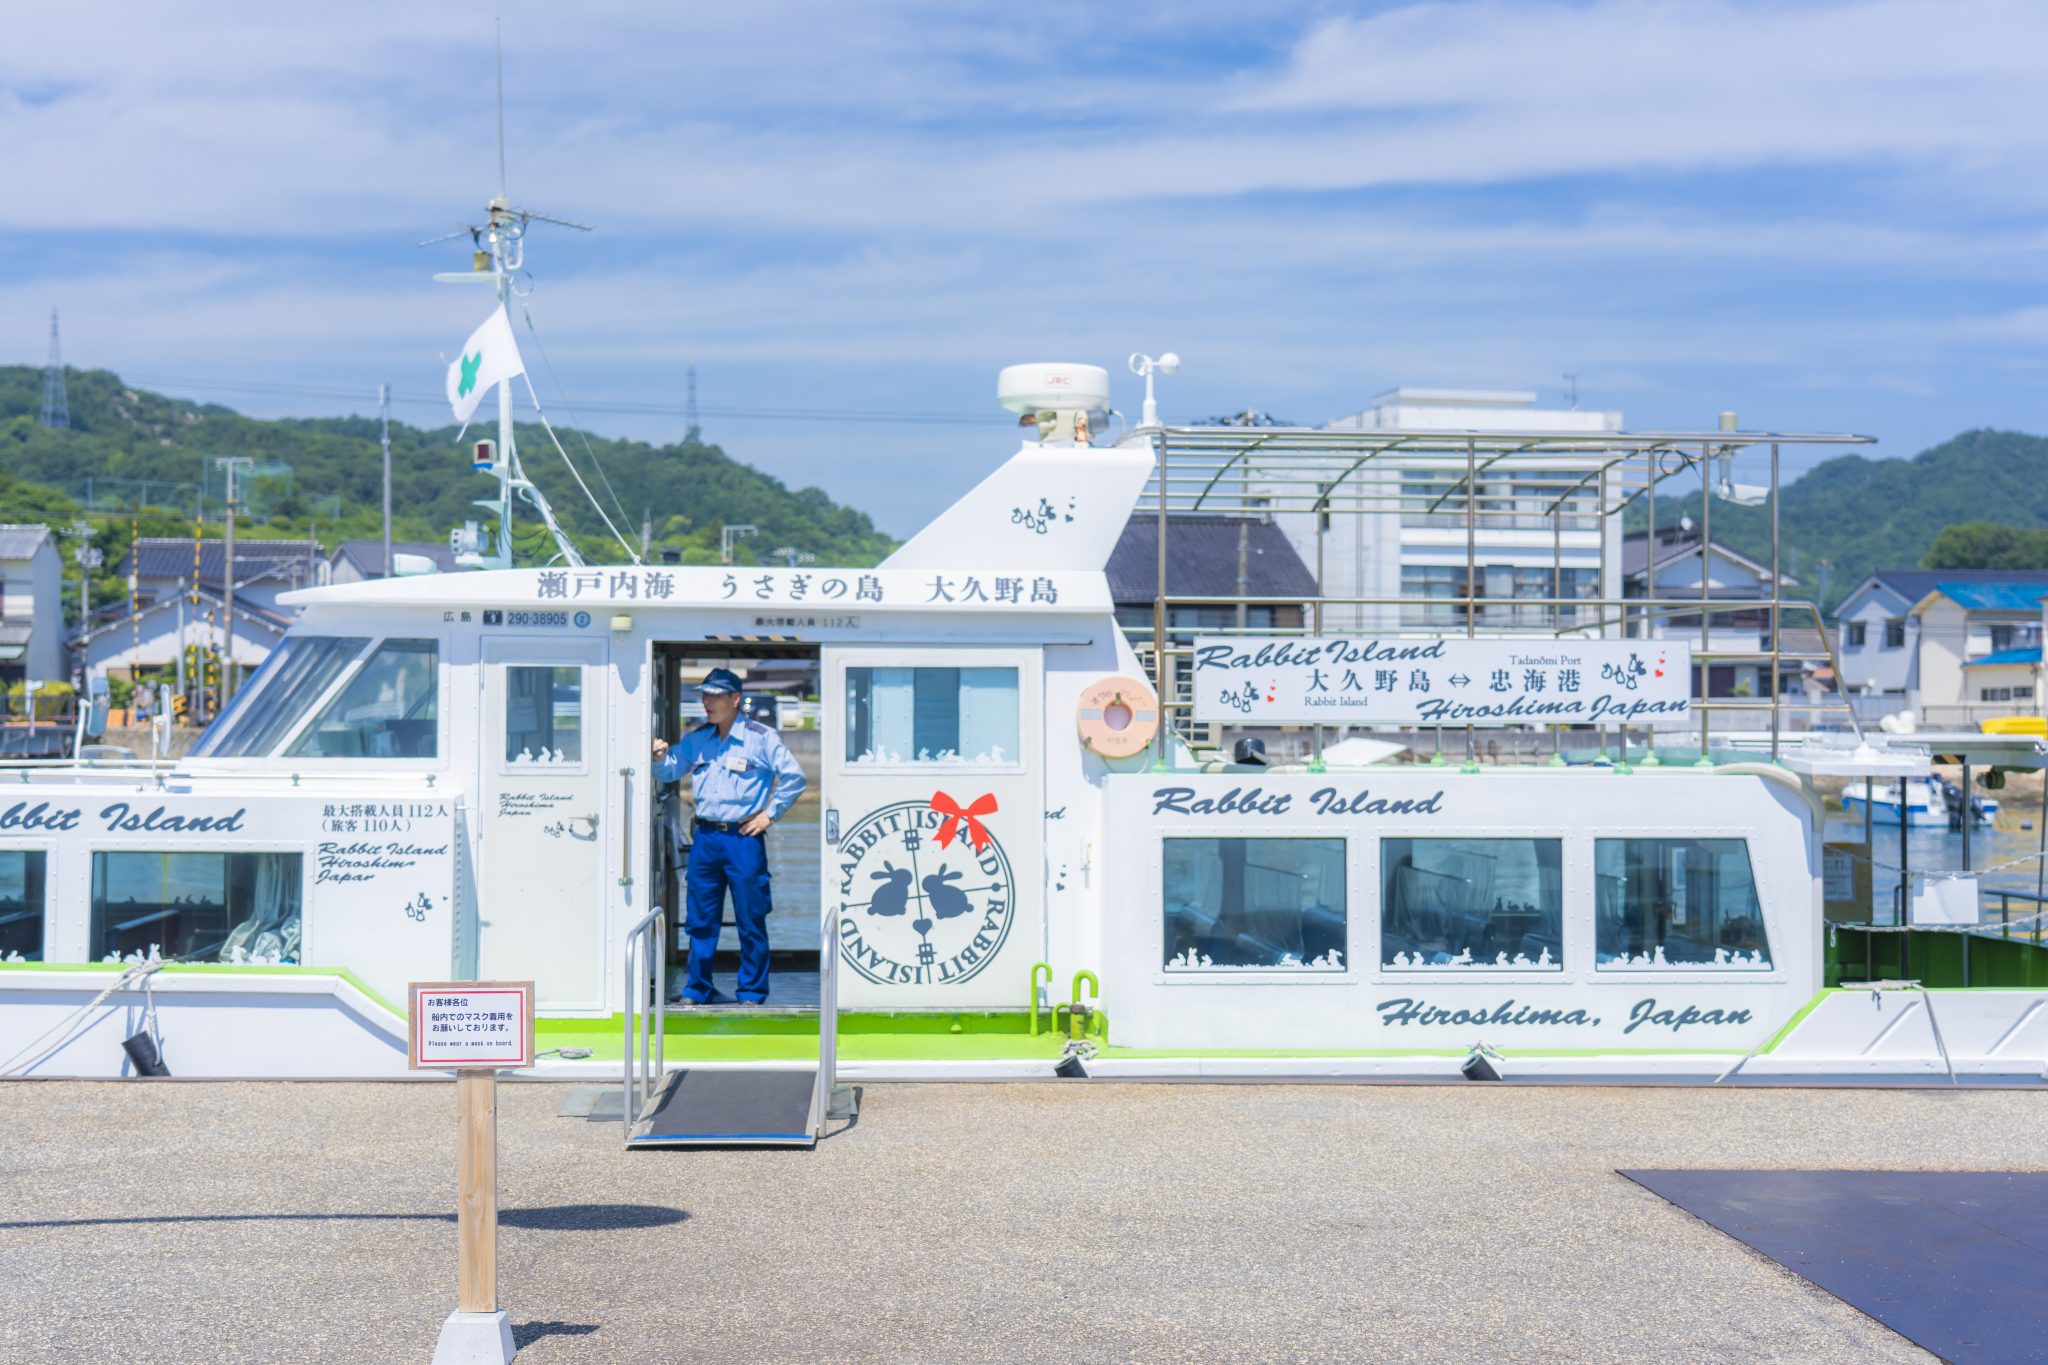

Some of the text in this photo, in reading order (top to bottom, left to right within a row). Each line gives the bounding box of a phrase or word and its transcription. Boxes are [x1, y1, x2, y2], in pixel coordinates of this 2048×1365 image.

[1047, 376, 1070, 385] JRC
[537, 571, 1058, 604] 瀬戸内海 うさぎの島 大久野島
[507, 612, 567, 625] 290-38905
[1196, 639, 1446, 671] Rabbit Island
[1560, 655, 1582, 665] Port
[1306, 668, 1581, 693] 大久野島 忠海港
[1304, 696, 1368, 707] Rabbit Island
[1416, 694, 1689, 721] Hiroshima Japan
[1152, 787, 1444, 815] Rabbit Island
[100, 803, 246, 831] Island
[497, 808, 531, 817] Japan
[318, 842, 448, 855] Rabbit Island
[841, 810, 999, 896] RABBIT ISAD
[841, 898, 1005, 985] RABBIT ISLAND
[427, 998, 468, 1007] お客様各位
[431, 1012, 513, 1021] 船内でのマスク着用を
[1375, 998, 1752, 1034] Hiroshima, Japan
[432, 1024, 510, 1032] お願いしております。
